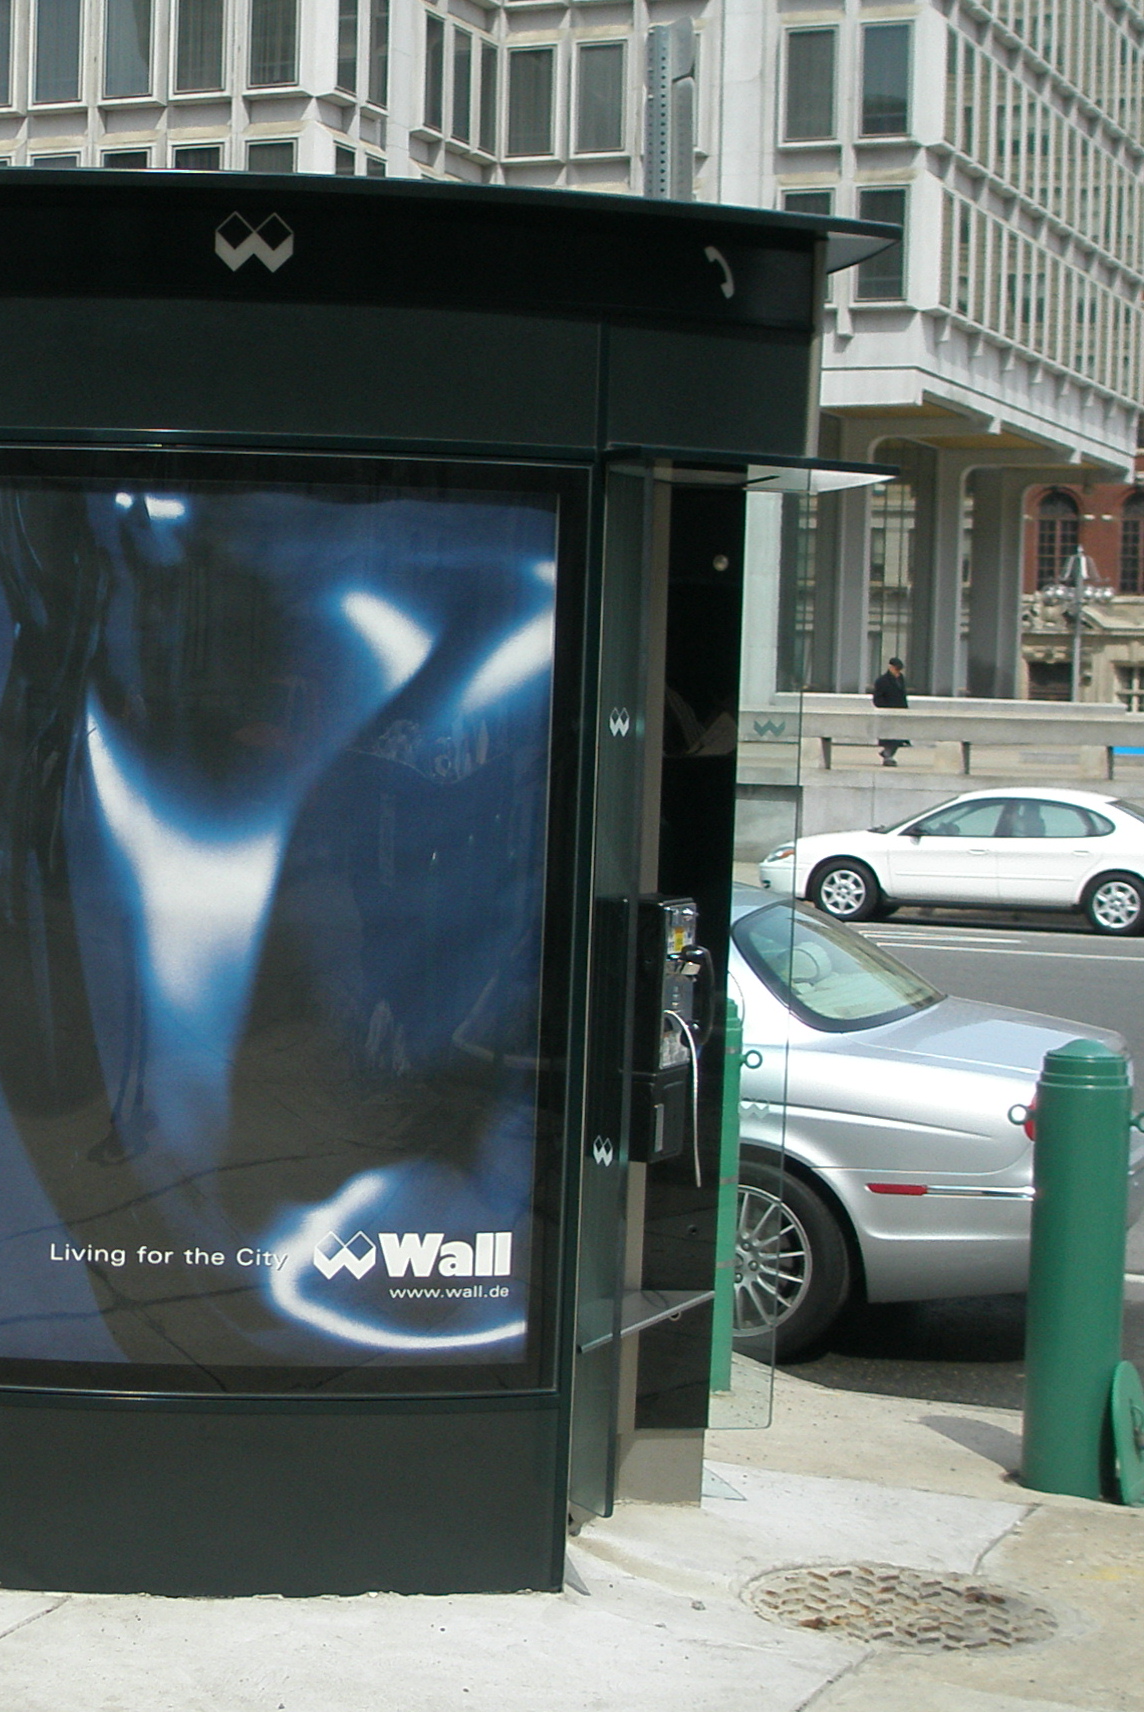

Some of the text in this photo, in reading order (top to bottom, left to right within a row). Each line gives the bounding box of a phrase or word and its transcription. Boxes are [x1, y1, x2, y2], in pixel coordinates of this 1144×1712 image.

[50, 1243, 289, 1271] Living for the City
[378, 1231, 513, 1278] Wall
[388, 1285, 510, 1300] www.wall.de
